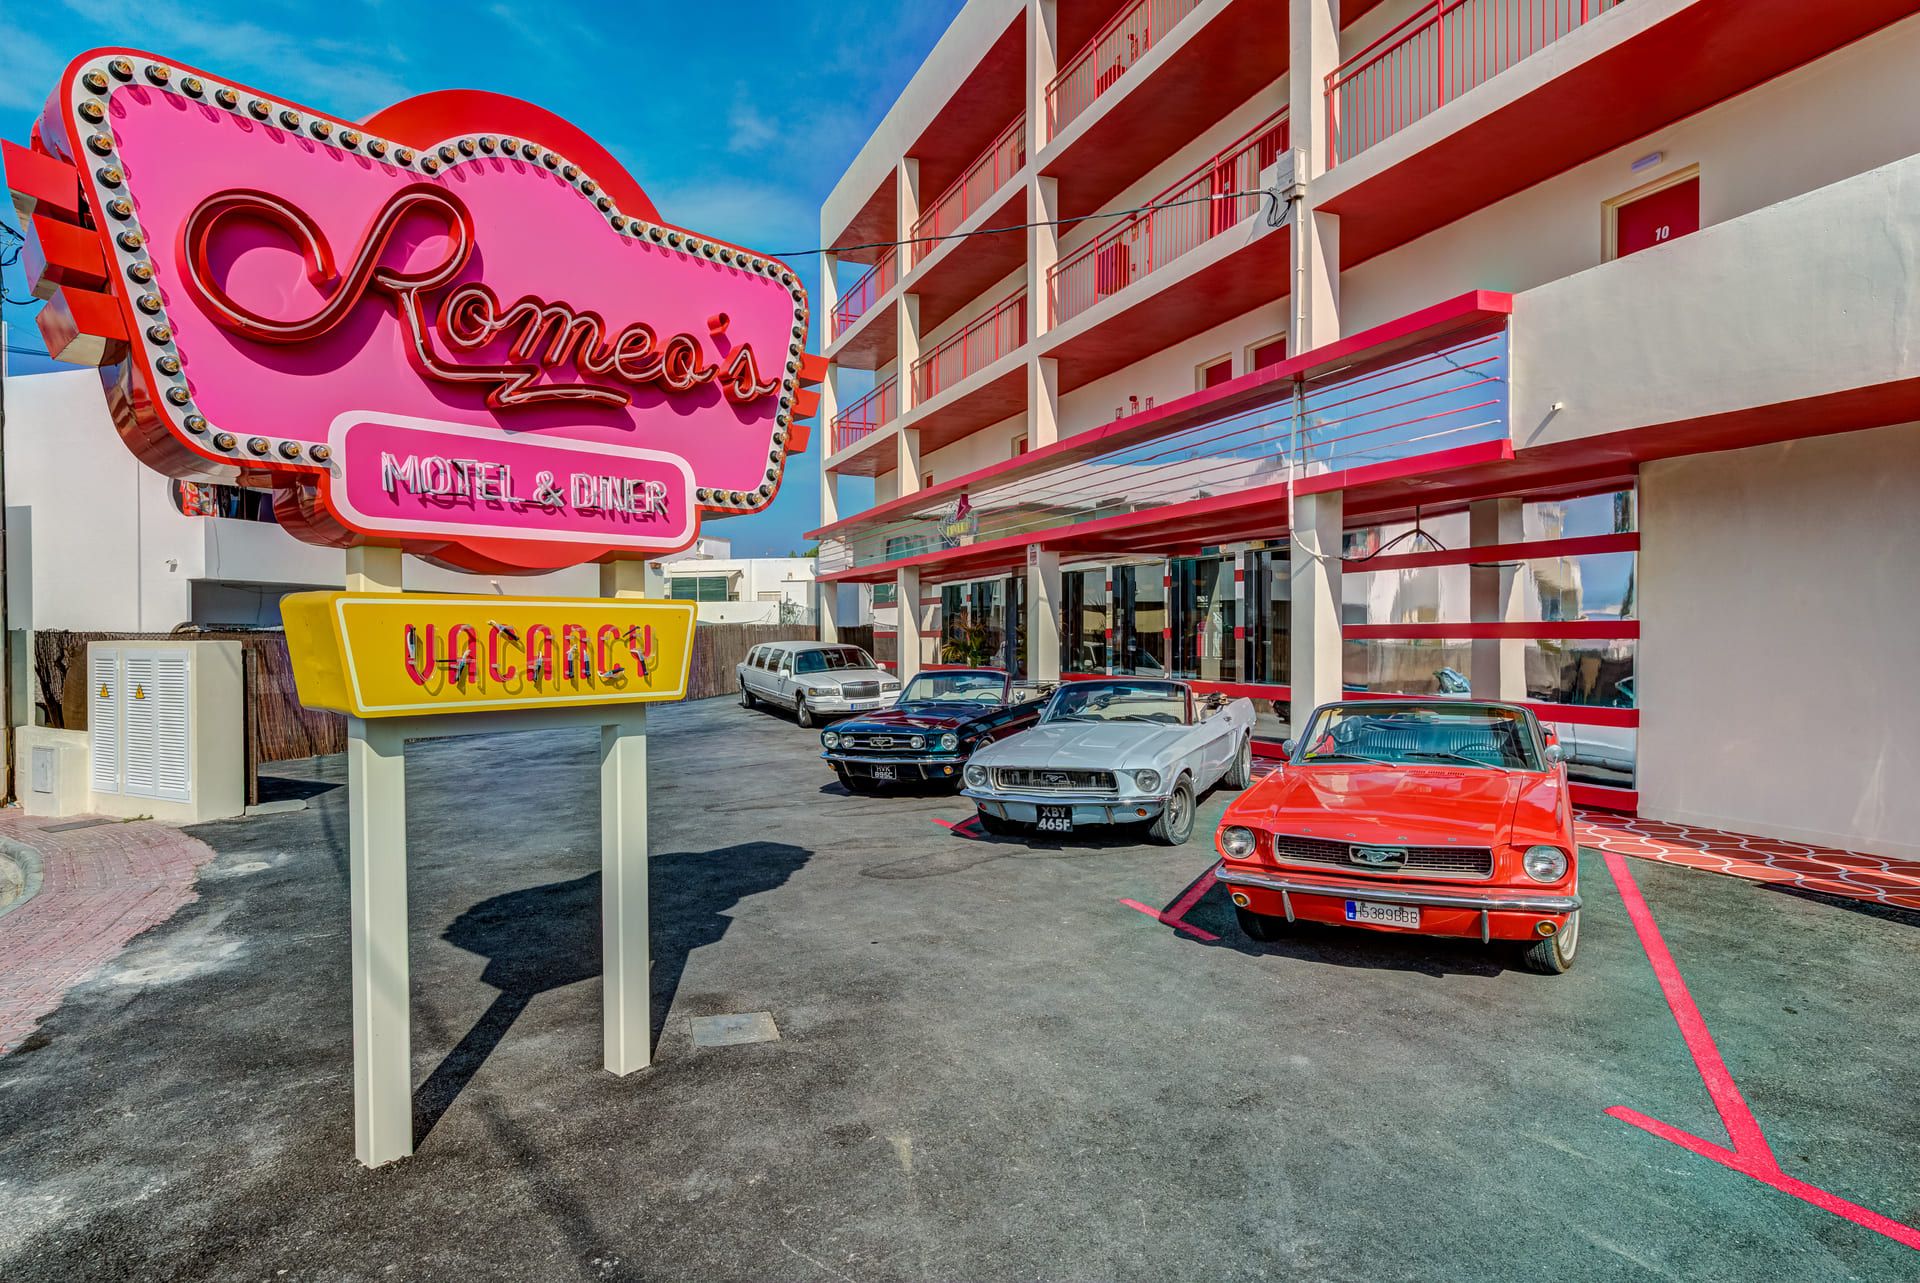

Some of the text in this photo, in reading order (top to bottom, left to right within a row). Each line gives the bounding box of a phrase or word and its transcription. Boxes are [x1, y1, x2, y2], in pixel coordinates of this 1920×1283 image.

[1655, 225, 1670, 241] 10
[176, 182, 781, 409] Romeo's
[380, 451, 668, 515] MOTEL & DINER
[404, 620, 656, 686] VACANCY
[1038, 818, 1071, 831] 465F
[1042, 807, 1066, 818] XBY
